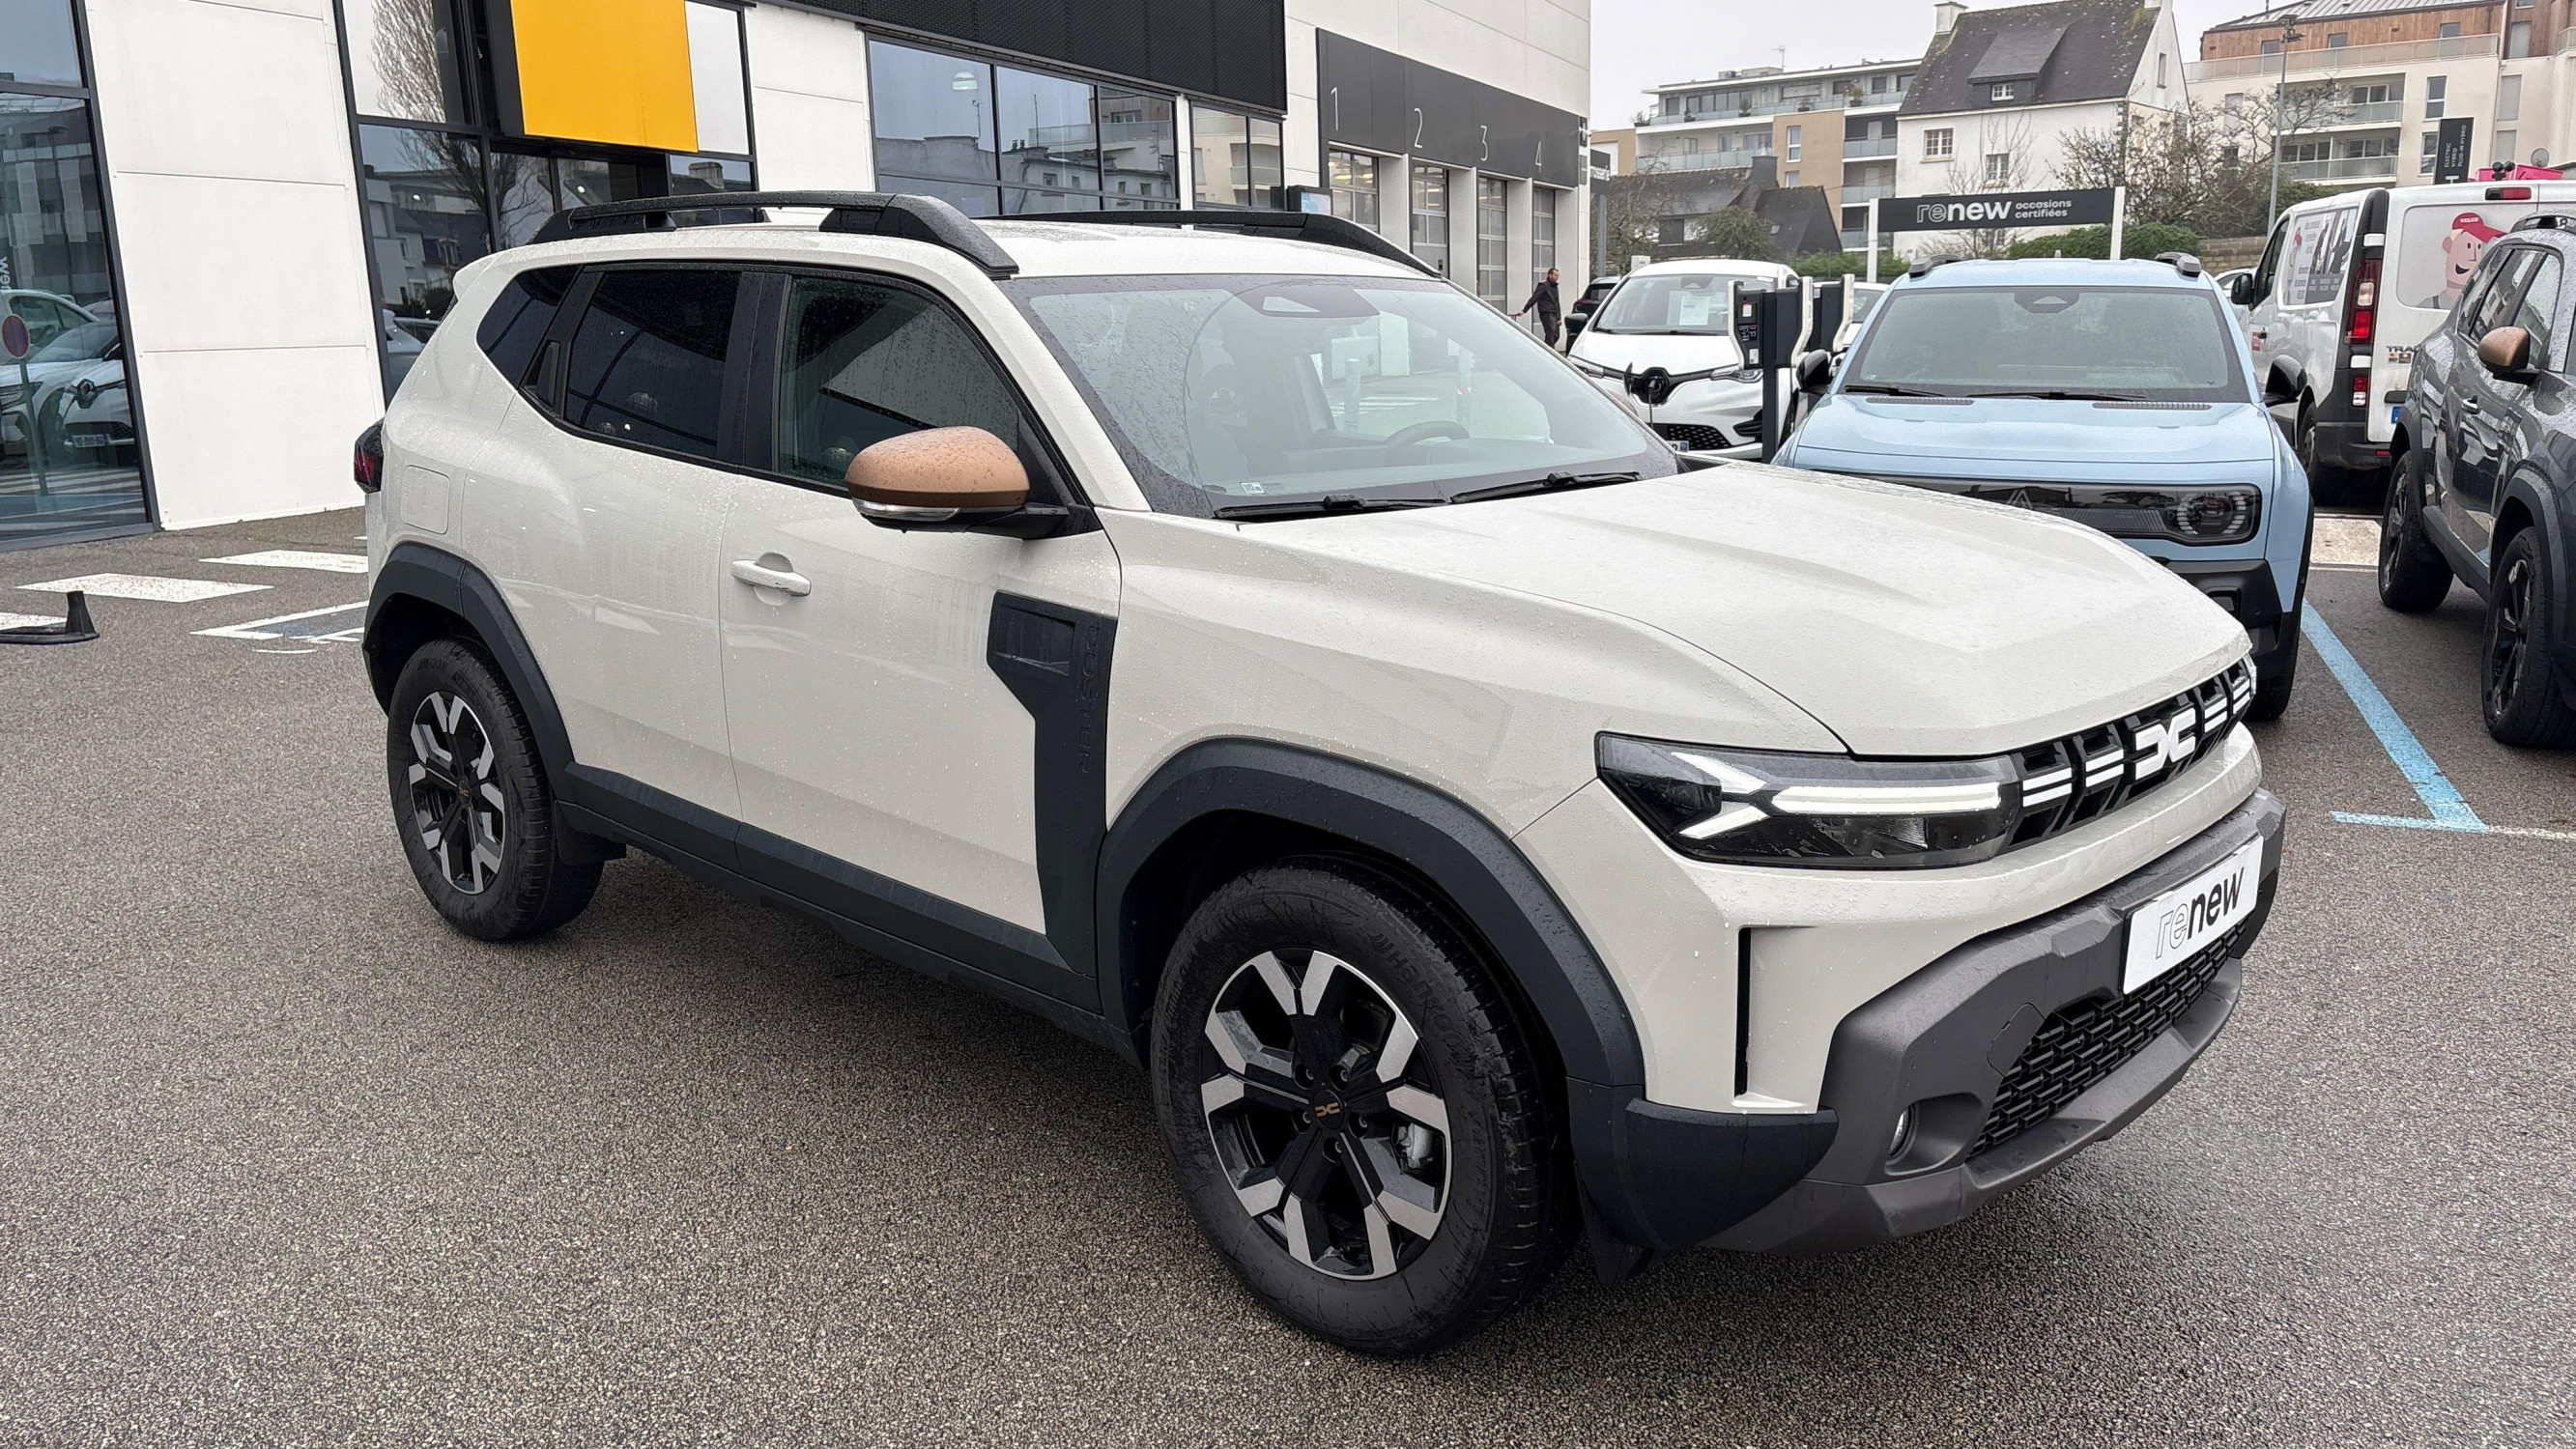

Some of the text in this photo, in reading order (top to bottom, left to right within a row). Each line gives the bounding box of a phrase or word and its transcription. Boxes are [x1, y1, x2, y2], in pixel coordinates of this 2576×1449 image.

[1331, 86, 1339, 131] 1
[1414, 107, 1423, 149] 2
[1480, 125, 1489, 161] 3
[1534, 140, 1543, 173] 4
[1916, 200, 2013, 223] renew
[2015, 199, 2072, 210] occasions
[2015, 209, 2068, 219] certifiées
[1078, 625, 1100, 774] DUSTER
[2155, 867, 2245, 959] renew
